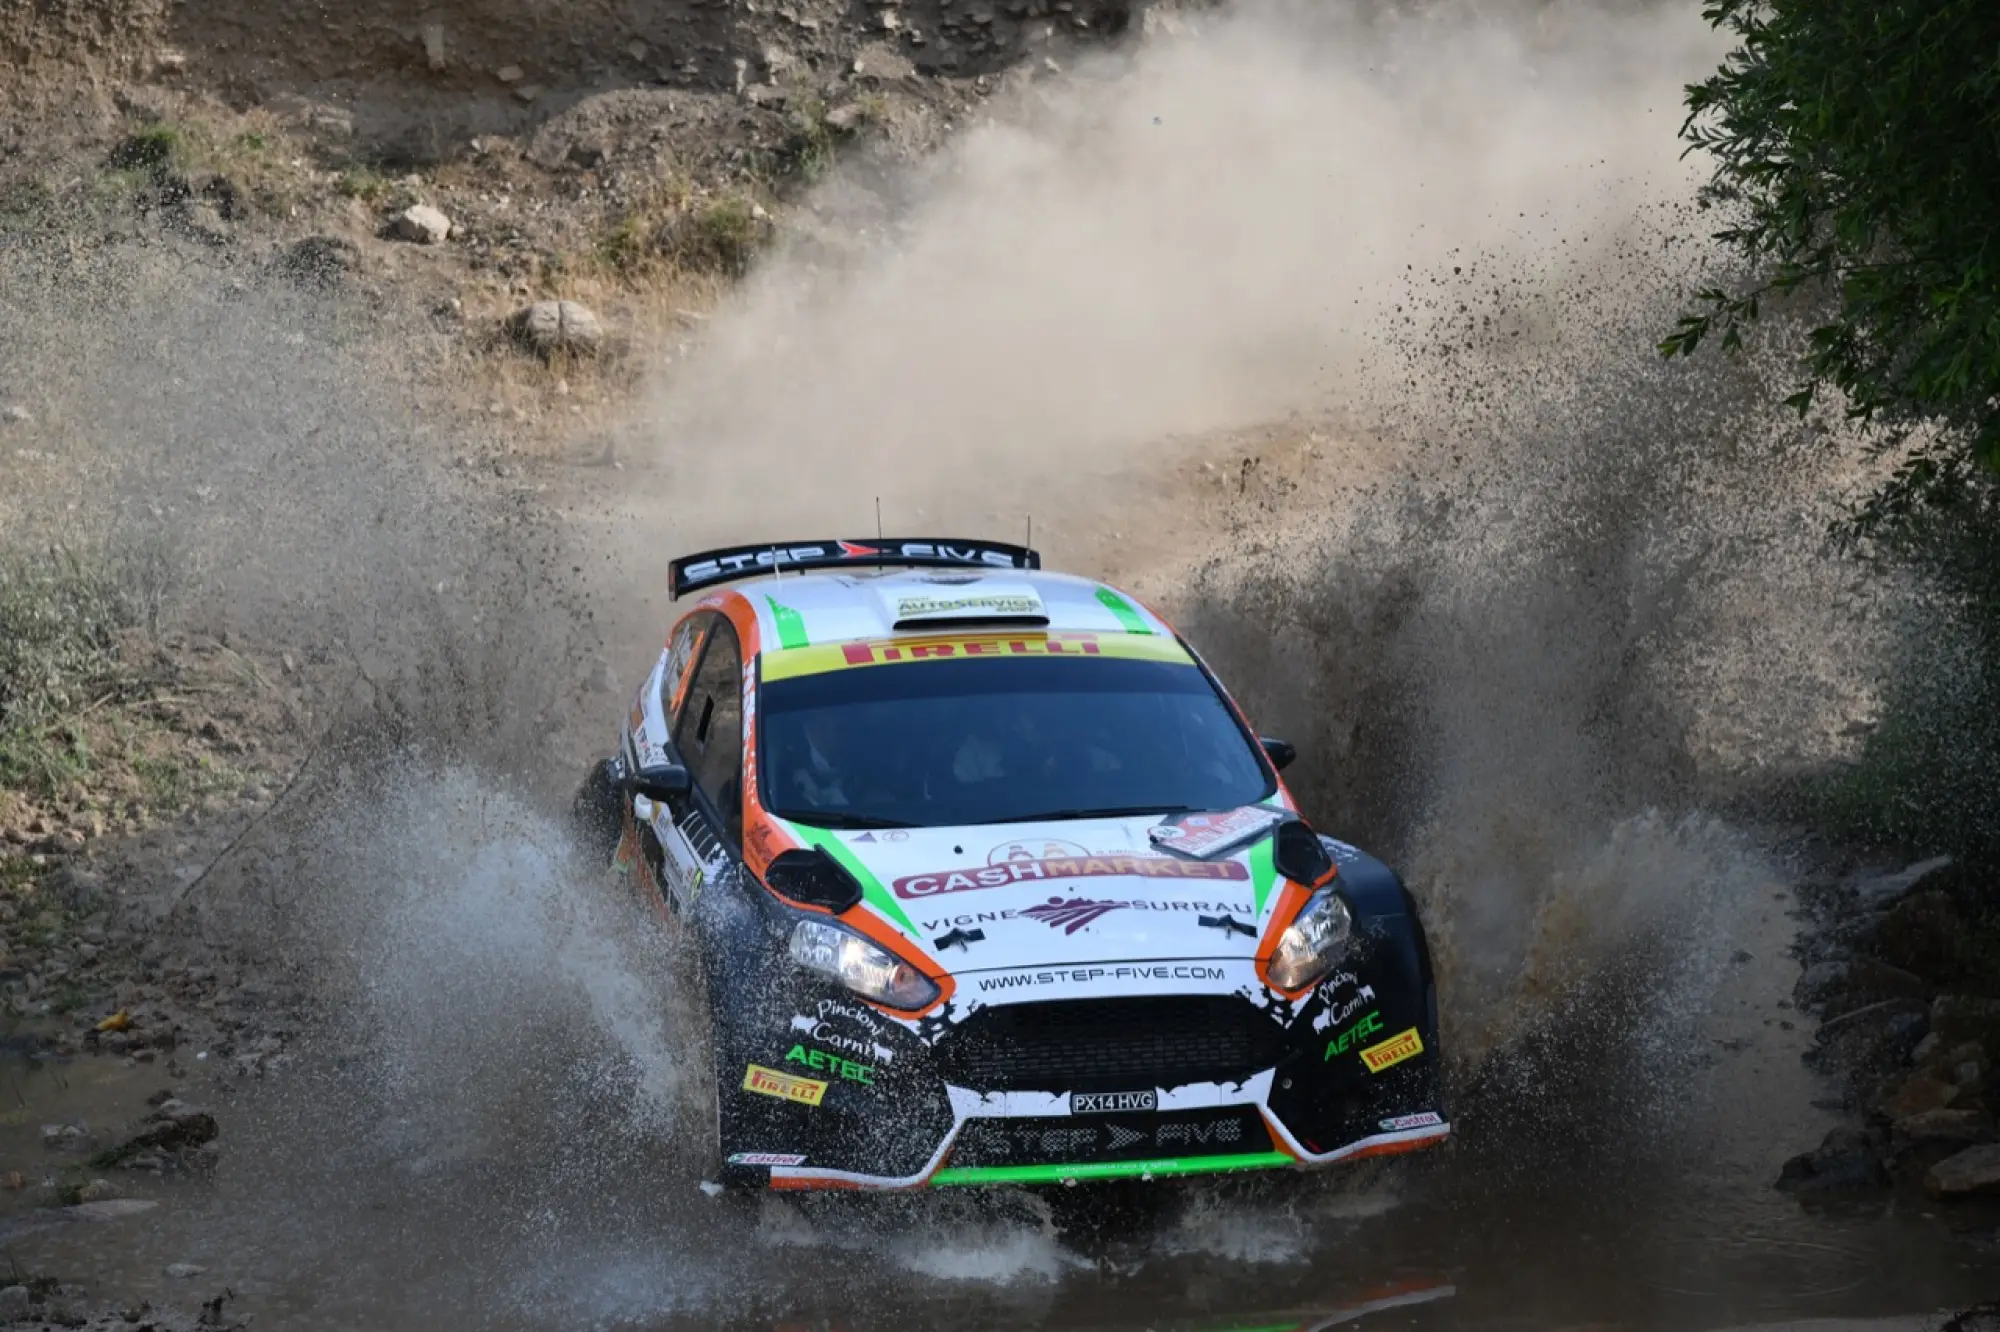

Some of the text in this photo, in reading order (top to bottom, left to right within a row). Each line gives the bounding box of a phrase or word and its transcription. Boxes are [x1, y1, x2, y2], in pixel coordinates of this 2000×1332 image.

[684, 543, 1014, 580] STEP FIVE
[841, 632, 1100, 665] PIRELLI
[922, 899, 1253, 931] VIGNE SURRAU
[978, 966, 1226, 992] WWW.STEP-FIVE.COM
[813, 1022, 871, 1055] Carni
[1324, 1009, 1384, 1062] AETEC
[1366, 1034, 1418, 1068] PIRELLI
[785, 1044, 876, 1085] AETEC
[751, 1070, 820, 1100] PIRELLI
[1075, 1092, 1153, 1111] PX14 HVG
[1156, 1118, 1241, 1147] FIVE
